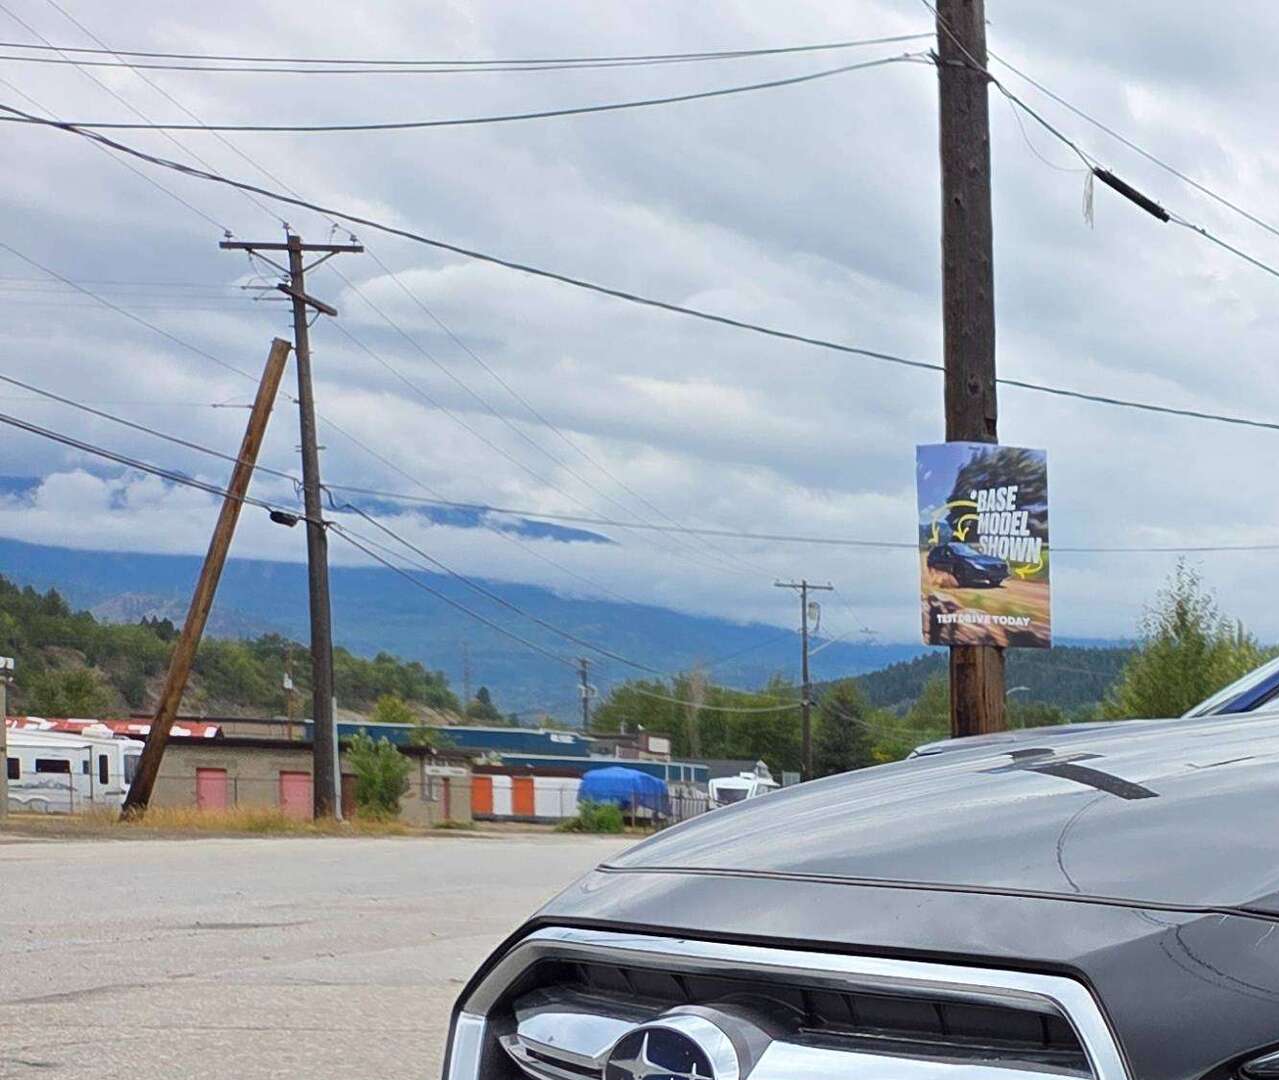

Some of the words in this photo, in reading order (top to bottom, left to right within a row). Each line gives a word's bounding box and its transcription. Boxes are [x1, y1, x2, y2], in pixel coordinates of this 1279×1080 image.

[977, 511, 1030, 536] MODEL
[979, 535, 1042, 563] SHOWN
[937, 613, 957, 624] TEST
[958, 613, 991, 625] DRIVE
[992, 615, 1031, 627] TODAY
